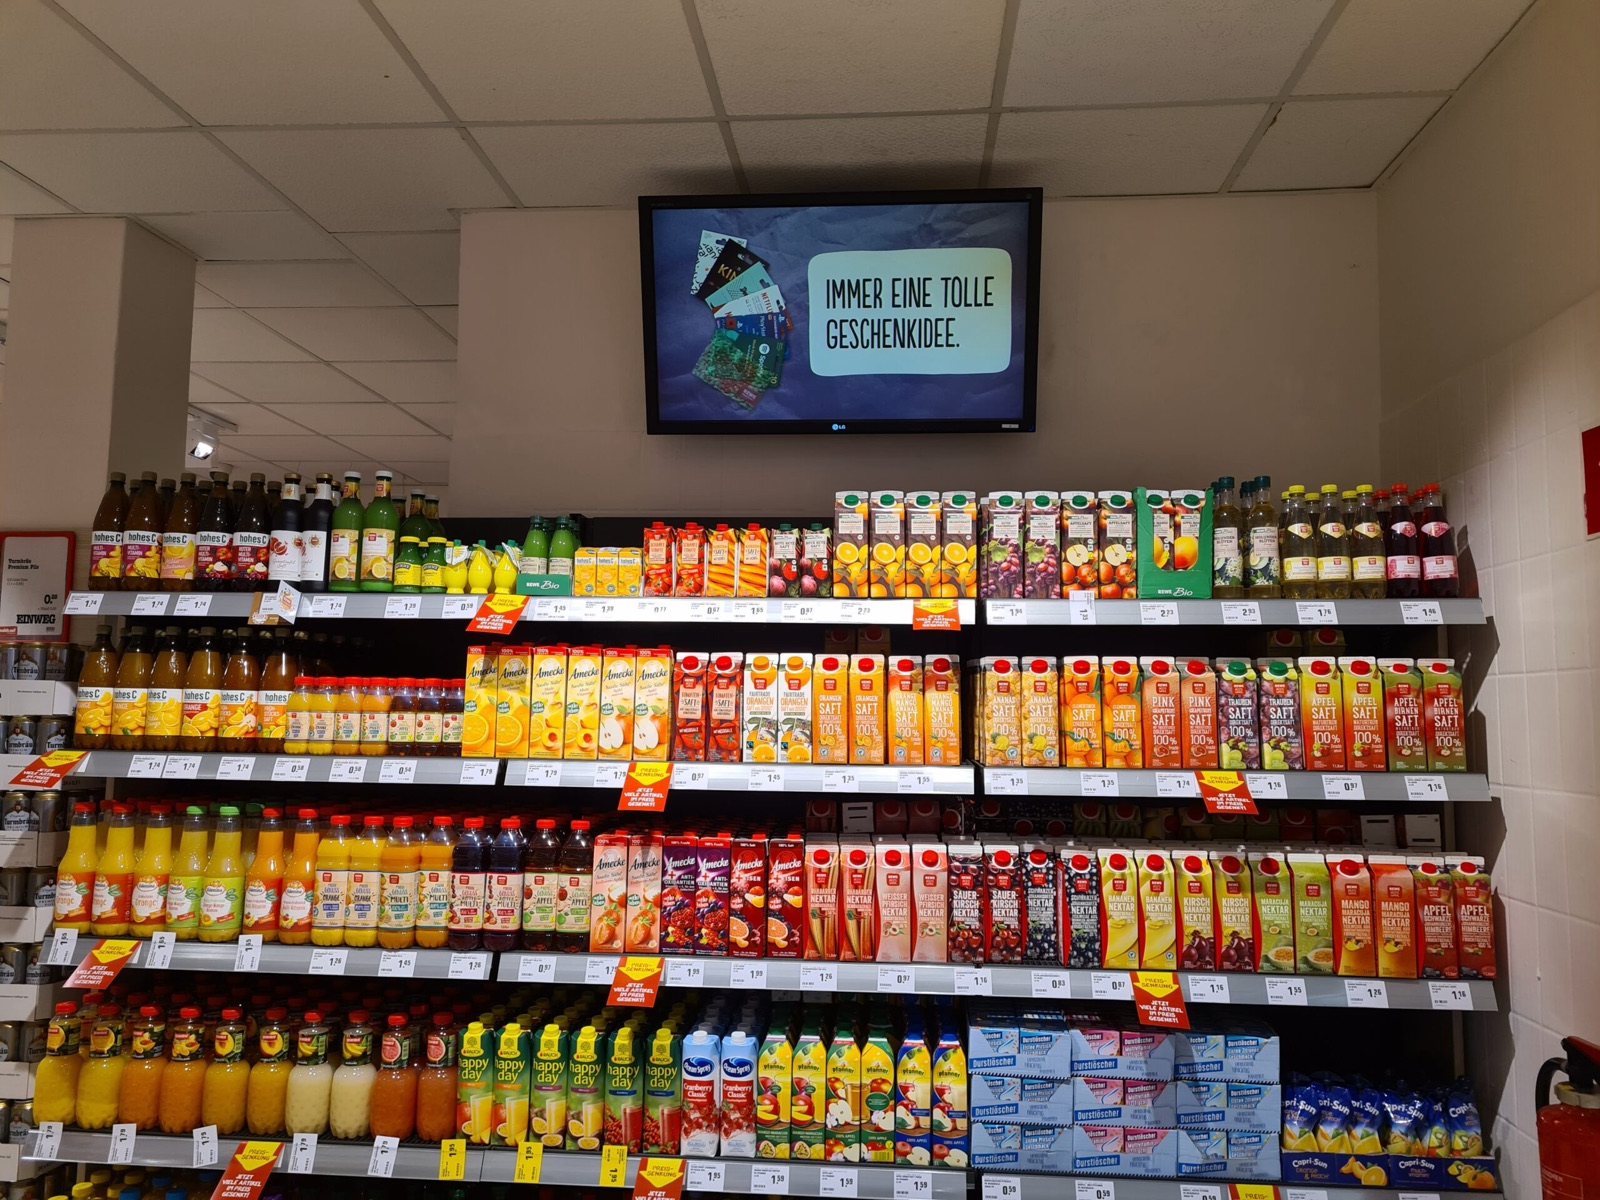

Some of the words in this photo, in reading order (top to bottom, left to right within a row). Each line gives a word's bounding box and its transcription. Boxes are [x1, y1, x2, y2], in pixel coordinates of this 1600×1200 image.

[826, 278, 882, 310] IMMER
[891, 277, 932, 308] EINE
[940, 276, 994, 308] TOLLE
[826, 318, 960, 350] GESCHENKIDEE.
[94, 532, 114, 542] hohes
[116, 534, 121, 542] C
[129, 532, 150, 542] hohes
[152, 534, 156, 542] C
[200, 533, 220, 542] hohes
[222, 534, 226, 543] C
[240, 534, 261, 543] hohes
[262, 536, 267, 544] C
[540, 580, 560, 590] Bio
[1172, 587, 1193, 597] Bio
[16, 614, 56, 624] EINWEG
[467, 666, 497, 679] Amecke
[499, 667, 529, 680] Amecke
[534, 666, 564, 680] Amecke
[603, 669, 633, 682] Amecke
[637, 669, 668, 682] Amecke
[205, 691, 210, 699] C
[746, 697, 774, 706] ORANGEN
[1152, 697, 1174, 707] PINK
[1189, 696, 1211, 707] PINK
[1312, 698, 1336, 706] APFEL
[1394, 698, 1417, 707] APFEL
[1433, 698, 1458, 707] APFEL
[819, 703, 842, 715] SAFT
[993, 705, 1016, 717] SAFT
[1030, 705, 1053, 717] SAFT
[1229, 707, 1252, 719] SAFT
[1270, 707, 1294, 719] SAFT
[1312, 707, 1336, 719] SAFT
[896, 711, 918, 723] SAFT
[1072, 709, 1096, 721] SAFT
[1152, 715, 1175, 726] SAFT
[1189, 714, 1212, 725] SAFT
[1395, 716, 1418, 726] SAFT
[594, 859, 626, 872] Amecke
[629, 858, 660, 872] Amecke
[664, 856, 695, 870] Amecke
[698, 858, 729, 872] Amecke
[732, 859, 763, 873] Amecke
[771, 859, 802, 873] Amecke
[953, 891, 980, 900] SAUER-
[953, 900, 979, 908] KIRSCH
[1109, 903, 1134, 911] NEKTAR
[1184, 898, 1210, 906] KIRSCH
[1342, 900, 1369, 909] MANGO
[1382, 902, 1410, 911] MANGO
[953, 909, 978, 917] NEKTAR
[1300, 908, 1327, 916] NEKTAR
[1424, 905, 1451, 915] APFEL
[1461, 905, 1489, 915] APFEL
[1184, 914, 1210, 922] NEKTAR
[1342, 916, 1370, 924] NEKTAR
[1382, 918, 1410, 927] NEKTAR
[495, 1056, 525, 1072] happy
[533, 1058, 565, 1074] happy
[570, 1060, 602, 1076] happy
[973, 1058, 1014, 1067] Durstlöscher
[1179, 1062, 1221, 1072] Durstlöscher
[607, 1063, 640, 1078] happy
[498, 1070, 518, 1084] day
[537, 1072, 558, 1085] day
[574, 1074, 595, 1088] day
[612, 1076, 633, 1090] day
[975, 1105, 1016, 1116] Durstlöscher
[1078, 1110, 1119, 1120] Durstlöscher
[1293, 1158, 1328, 1169] Capri-Sun
[1399, 1159, 1435, 1170] Capri-Sun
